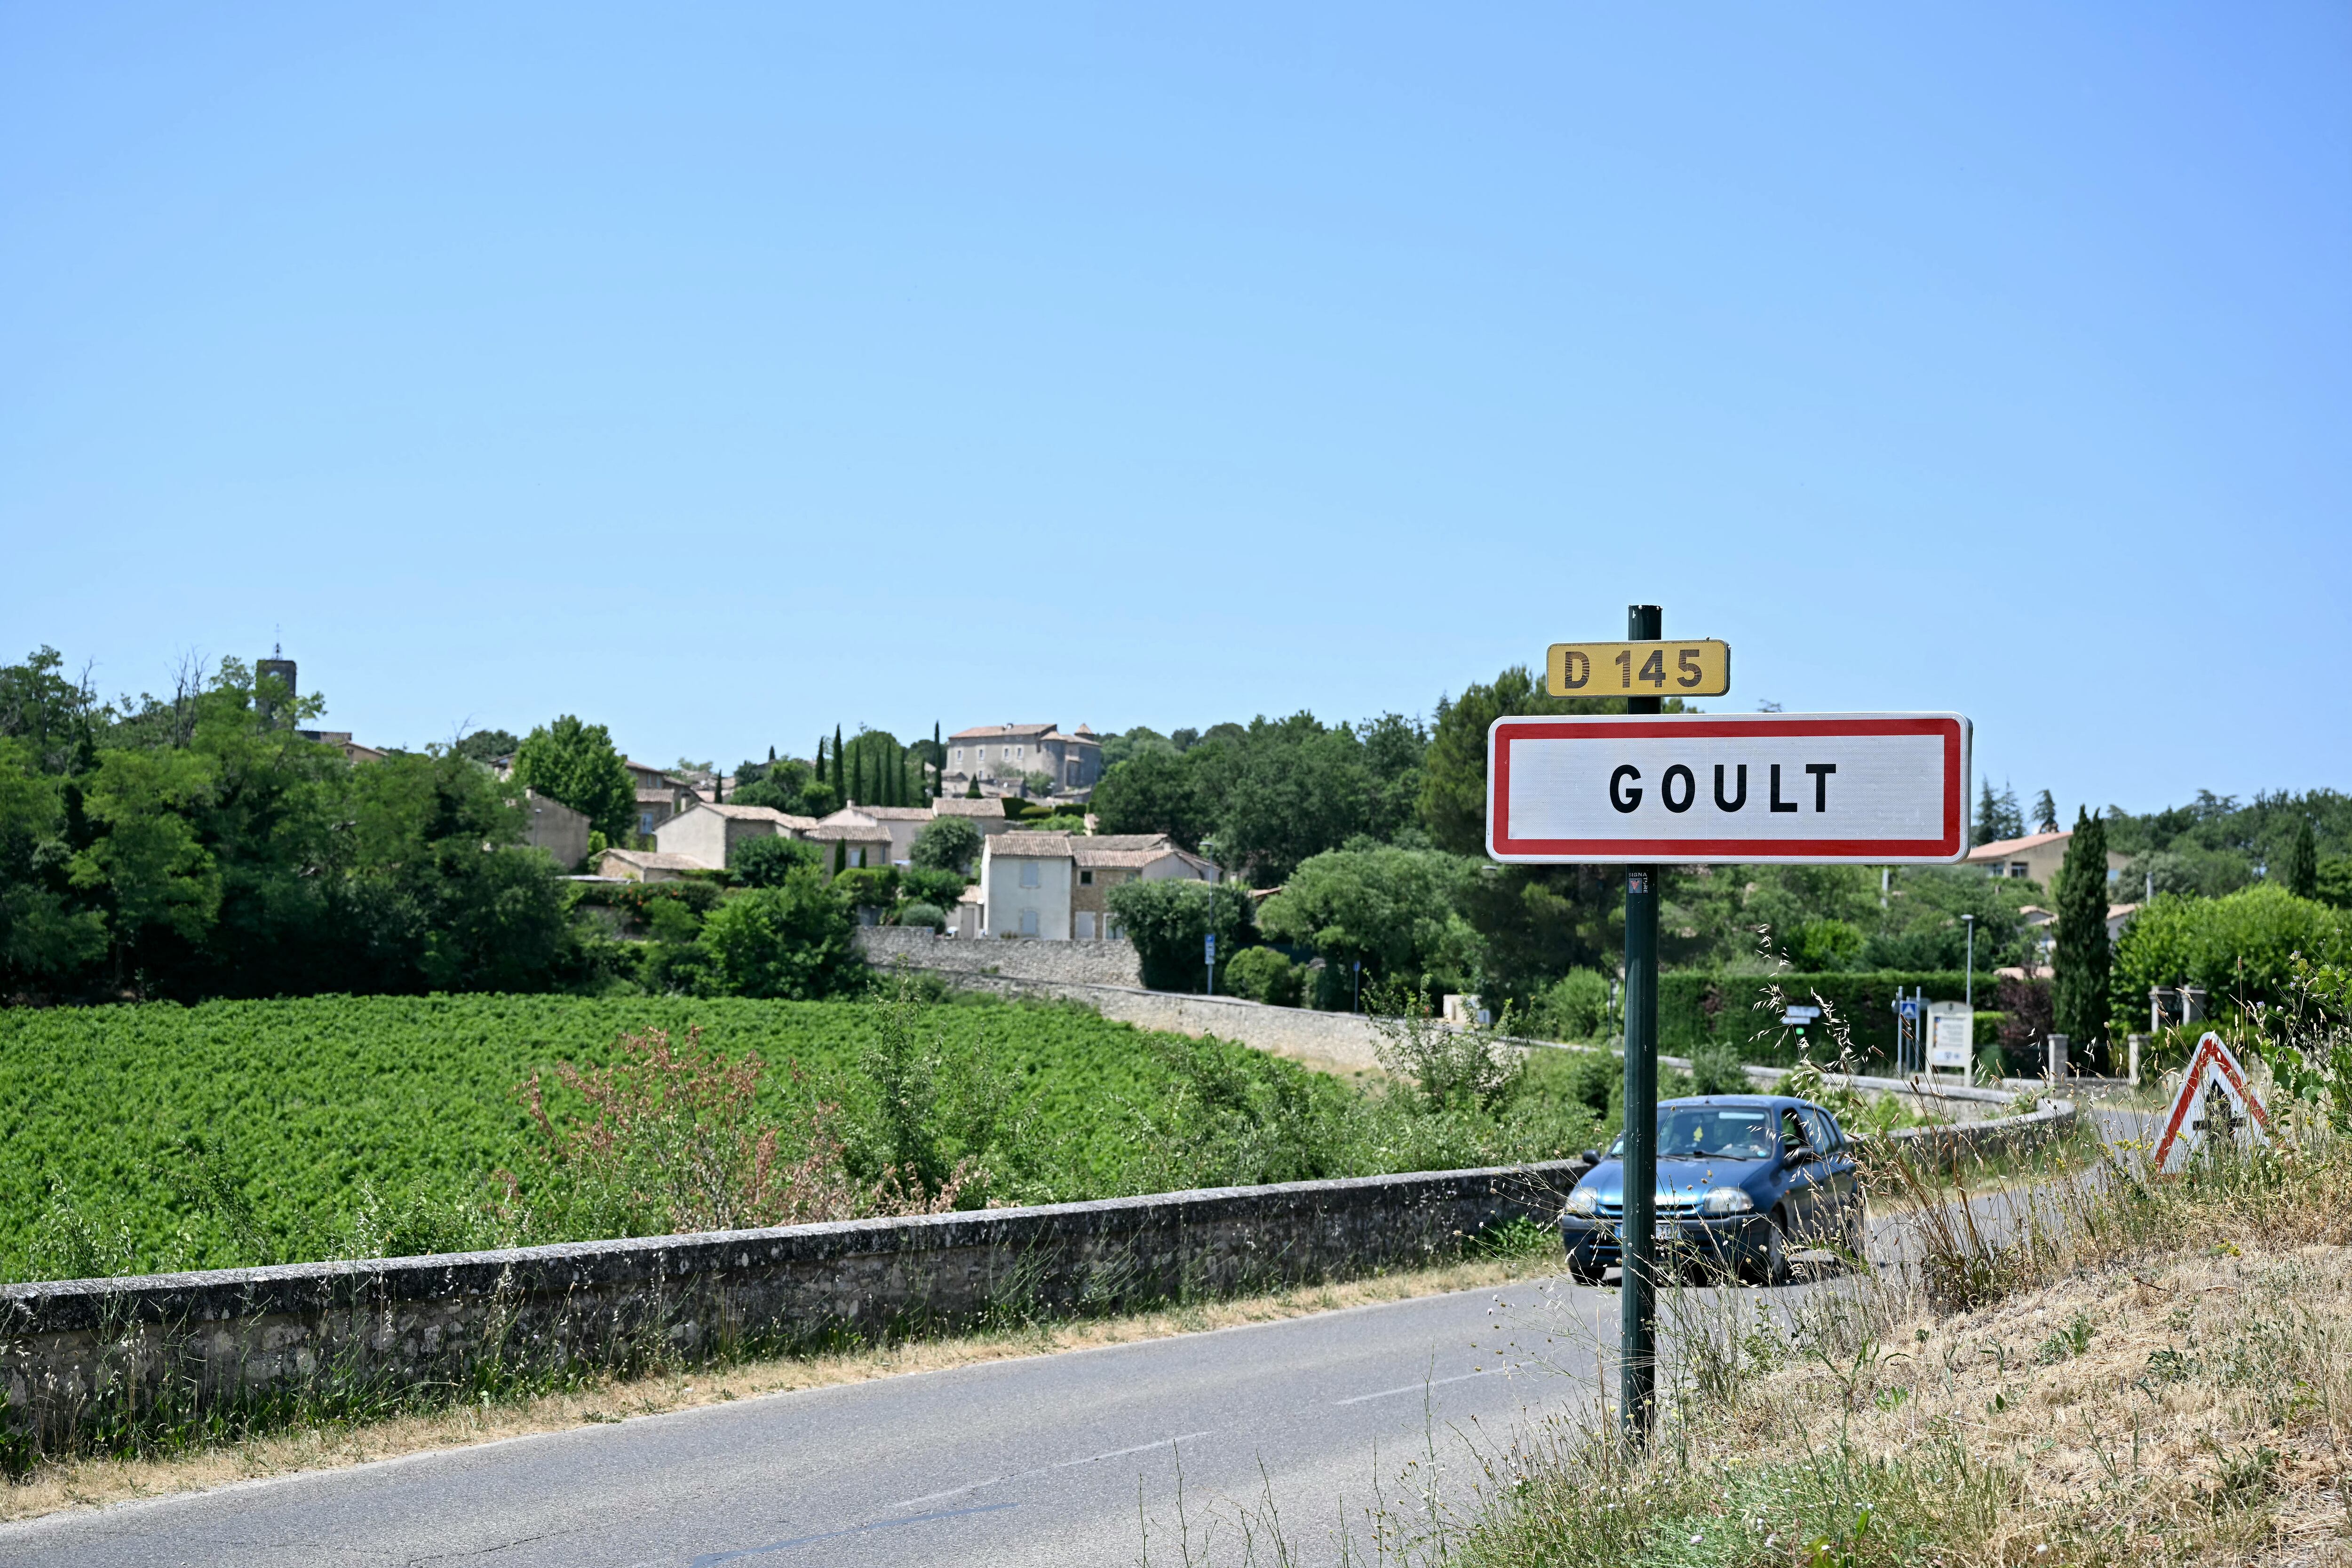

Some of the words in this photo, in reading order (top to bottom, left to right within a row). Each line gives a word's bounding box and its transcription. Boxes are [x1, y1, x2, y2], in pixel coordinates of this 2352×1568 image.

[1565, 652, 1590, 689] D
[1615, 649, 1702, 688] 145
[1609, 764, 1836, 813] GOULT
